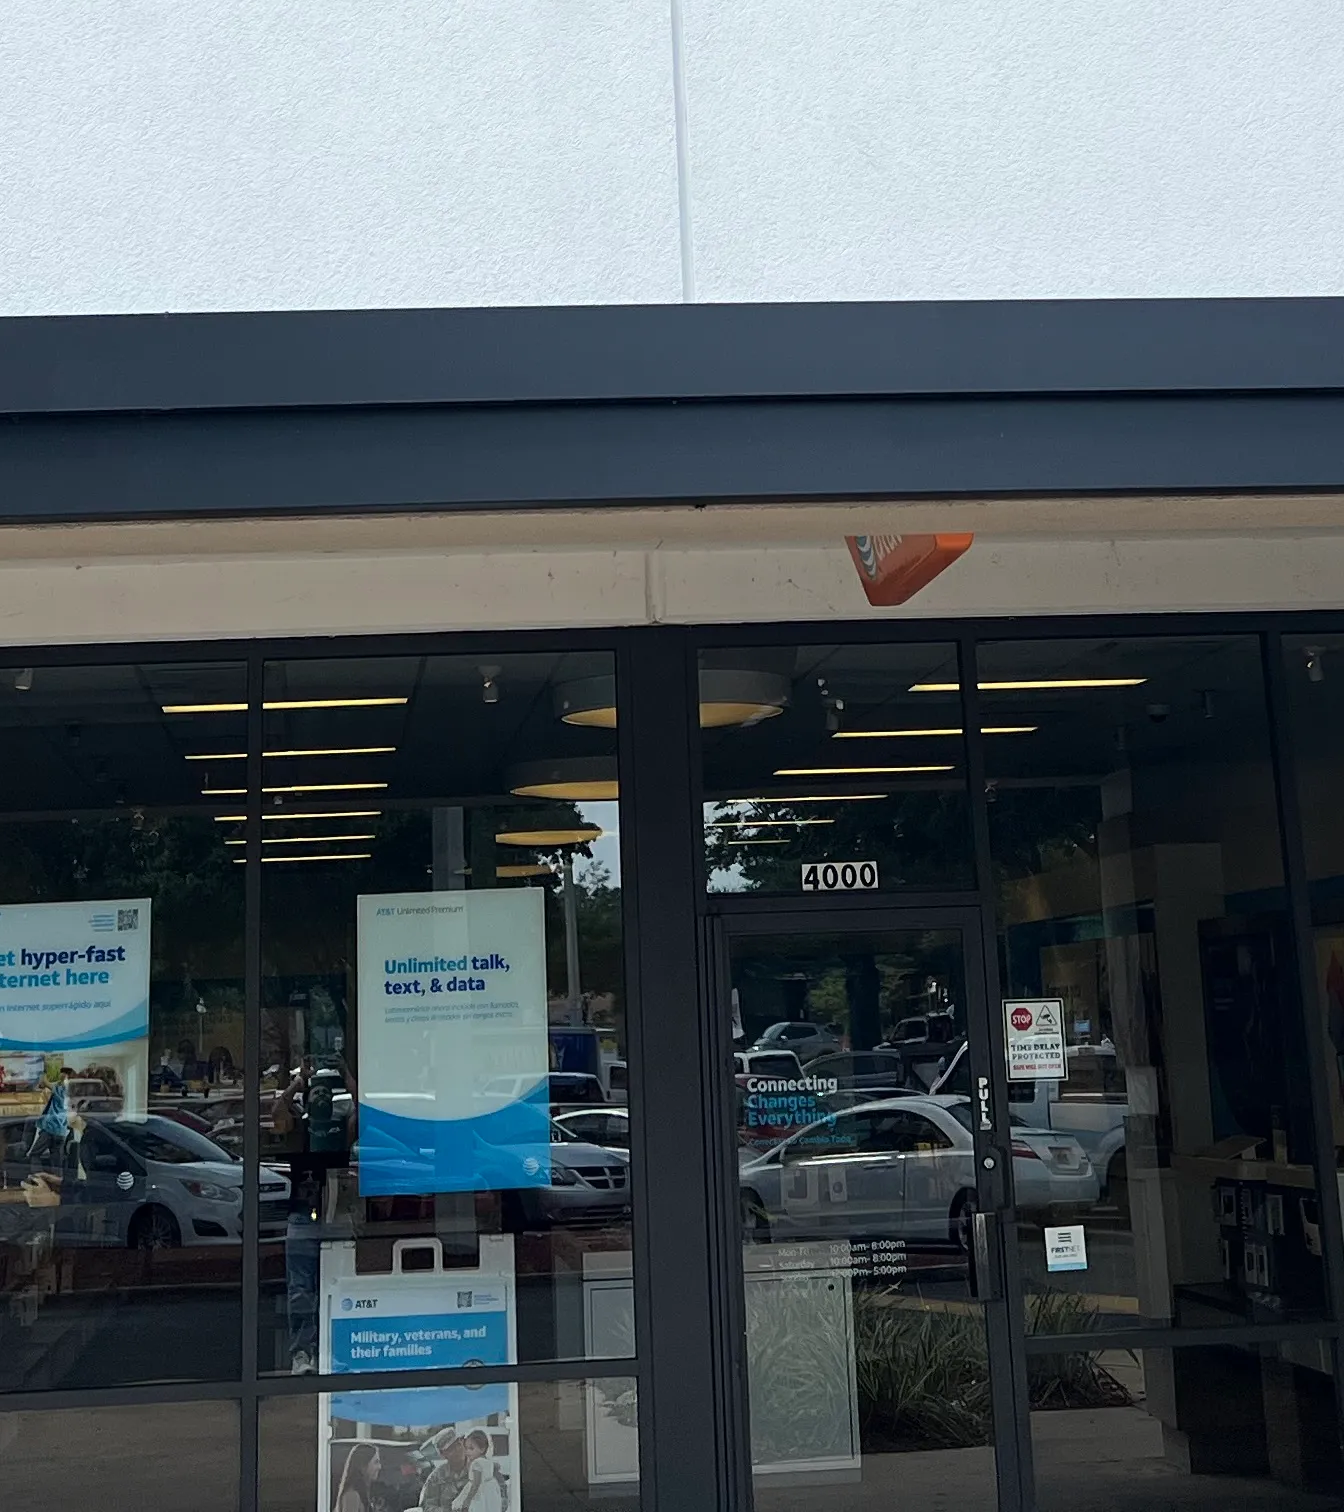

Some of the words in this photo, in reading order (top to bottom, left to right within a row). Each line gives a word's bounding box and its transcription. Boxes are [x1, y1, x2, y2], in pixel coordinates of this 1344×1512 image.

[803, 863, 876, 890] 4000
[21, 945, 125, 970] hyper-fast
[384, 955, 468, 975] Unlimited
[471, 954, 510, 973] talk,
[66, 968, 109, 986] here
[384, 979, 426, 996] text,
[430, 978, 443, 993] &
[447, 976, 486, 992] data
[1012, 1015, 1032, 1024] STOP
[1012, 1052, 1061, 1060] PROTECTED
[746, 1075, 838, 1094] Connecting
[747, 1094, 816, 1111] Changes
[978, 1077, 991, 1123] PULL
[747, 1108, 837, 1130] Everything
[355, 1299, 378, 1309] AT&T
[351, 1330, 402, 1345] Military,
[404, 1328, 462, 1342] veterans,
[463, 1326, 487, 1338] and
[351, 1346, 380, 1359] their
[383, 1344, 433, 1357] families
